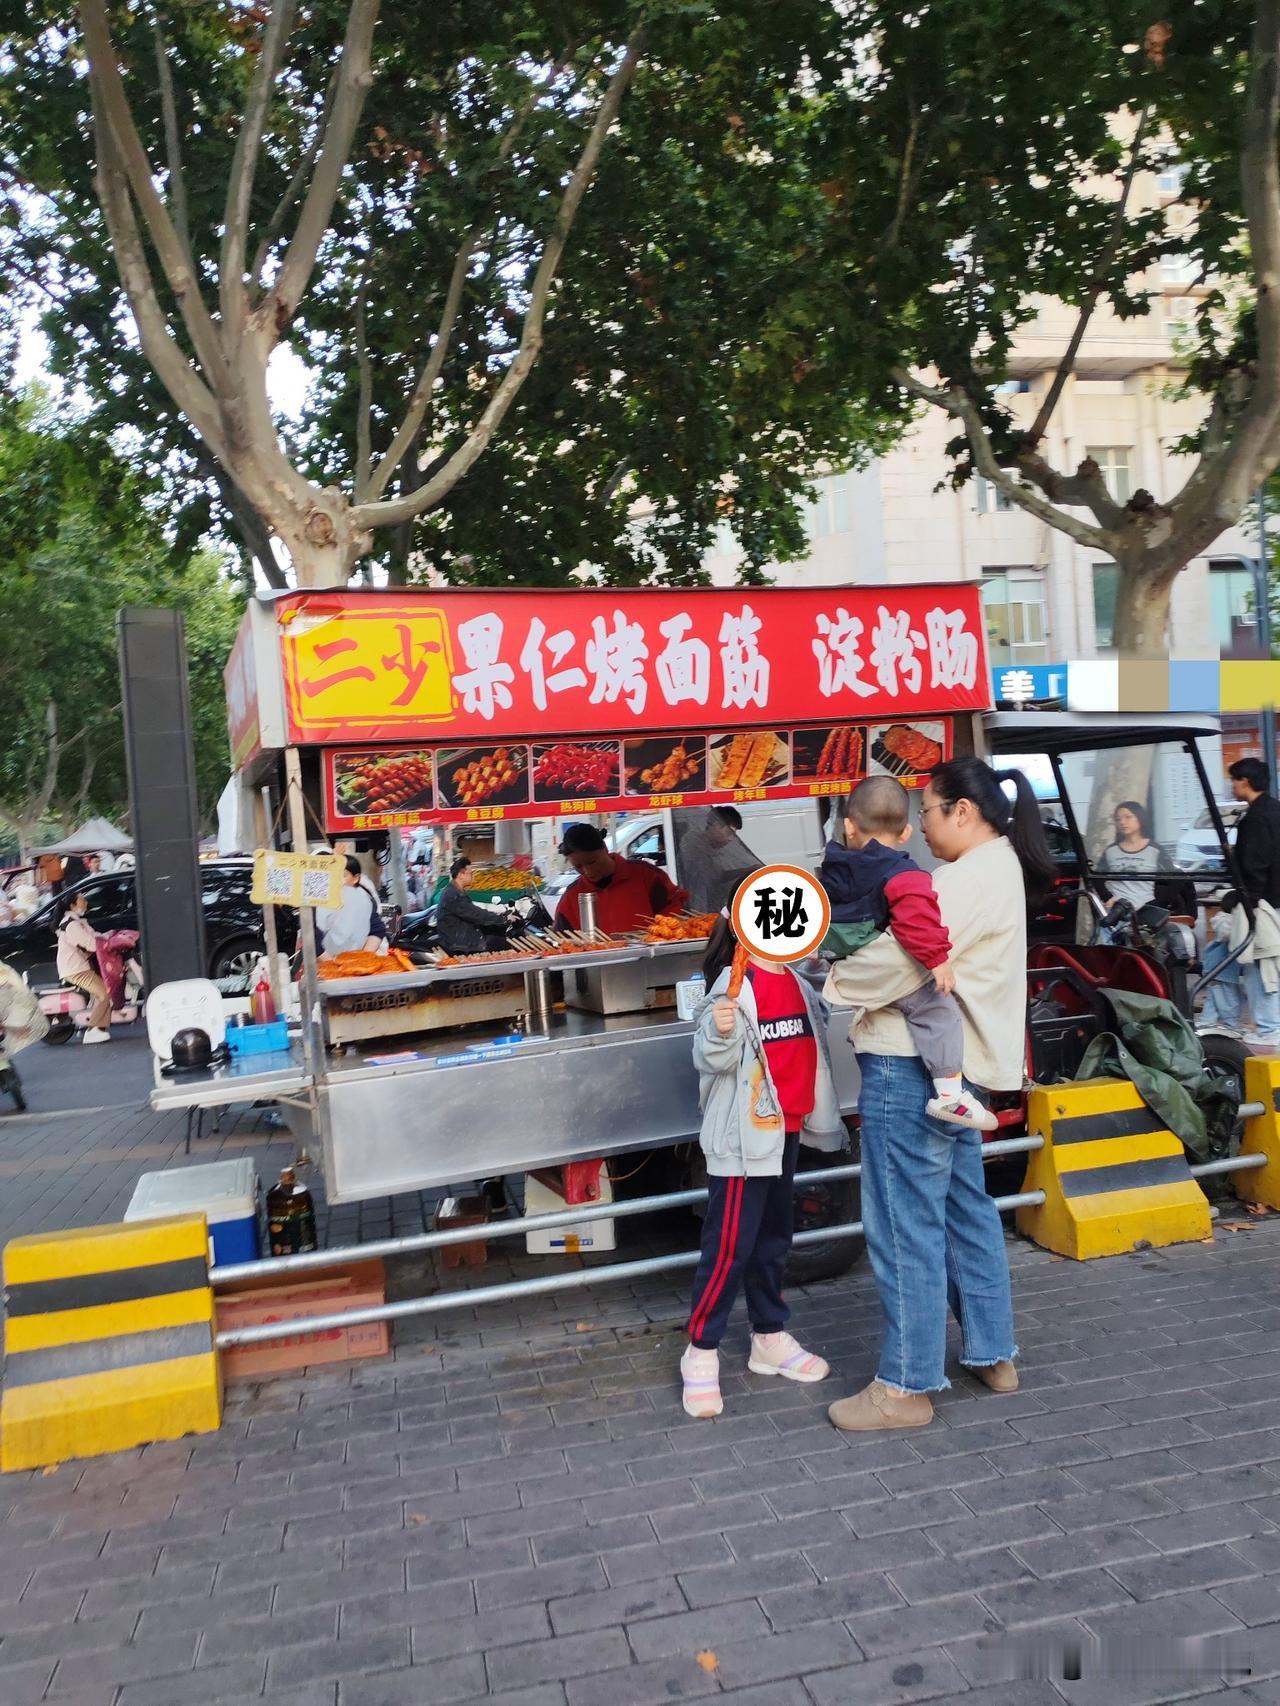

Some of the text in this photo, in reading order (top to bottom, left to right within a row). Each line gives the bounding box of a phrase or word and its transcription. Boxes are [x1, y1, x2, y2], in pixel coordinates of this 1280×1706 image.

[301, 624, 441, 706] 二少
[451, 604, 978, 720] 果仁烤面筋 淀粉肠
[560, 800, 597, 813] 热狗肠
[649, 795, 683, 807] 龙虾球
